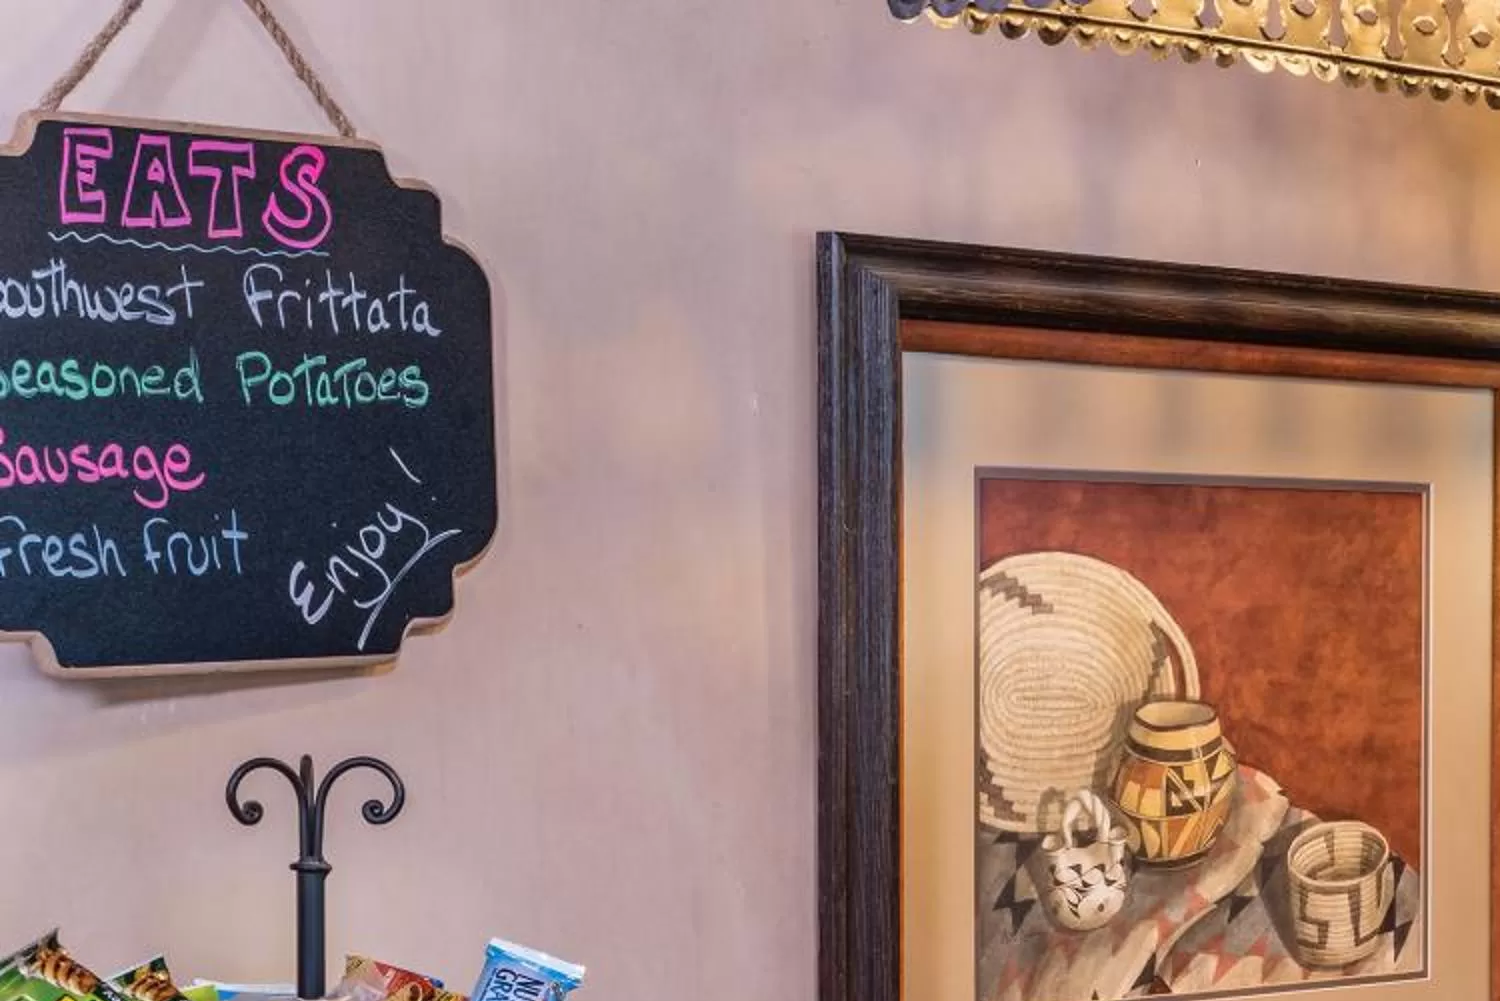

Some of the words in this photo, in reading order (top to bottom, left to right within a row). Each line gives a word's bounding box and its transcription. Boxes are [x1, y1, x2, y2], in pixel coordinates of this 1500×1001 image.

[60, 127, 332, 249] EATS
[0, 257, 205, 325] outhwest
[242, 263, 442, 337] Frittata
[143, 508, 249, 575] fruit
